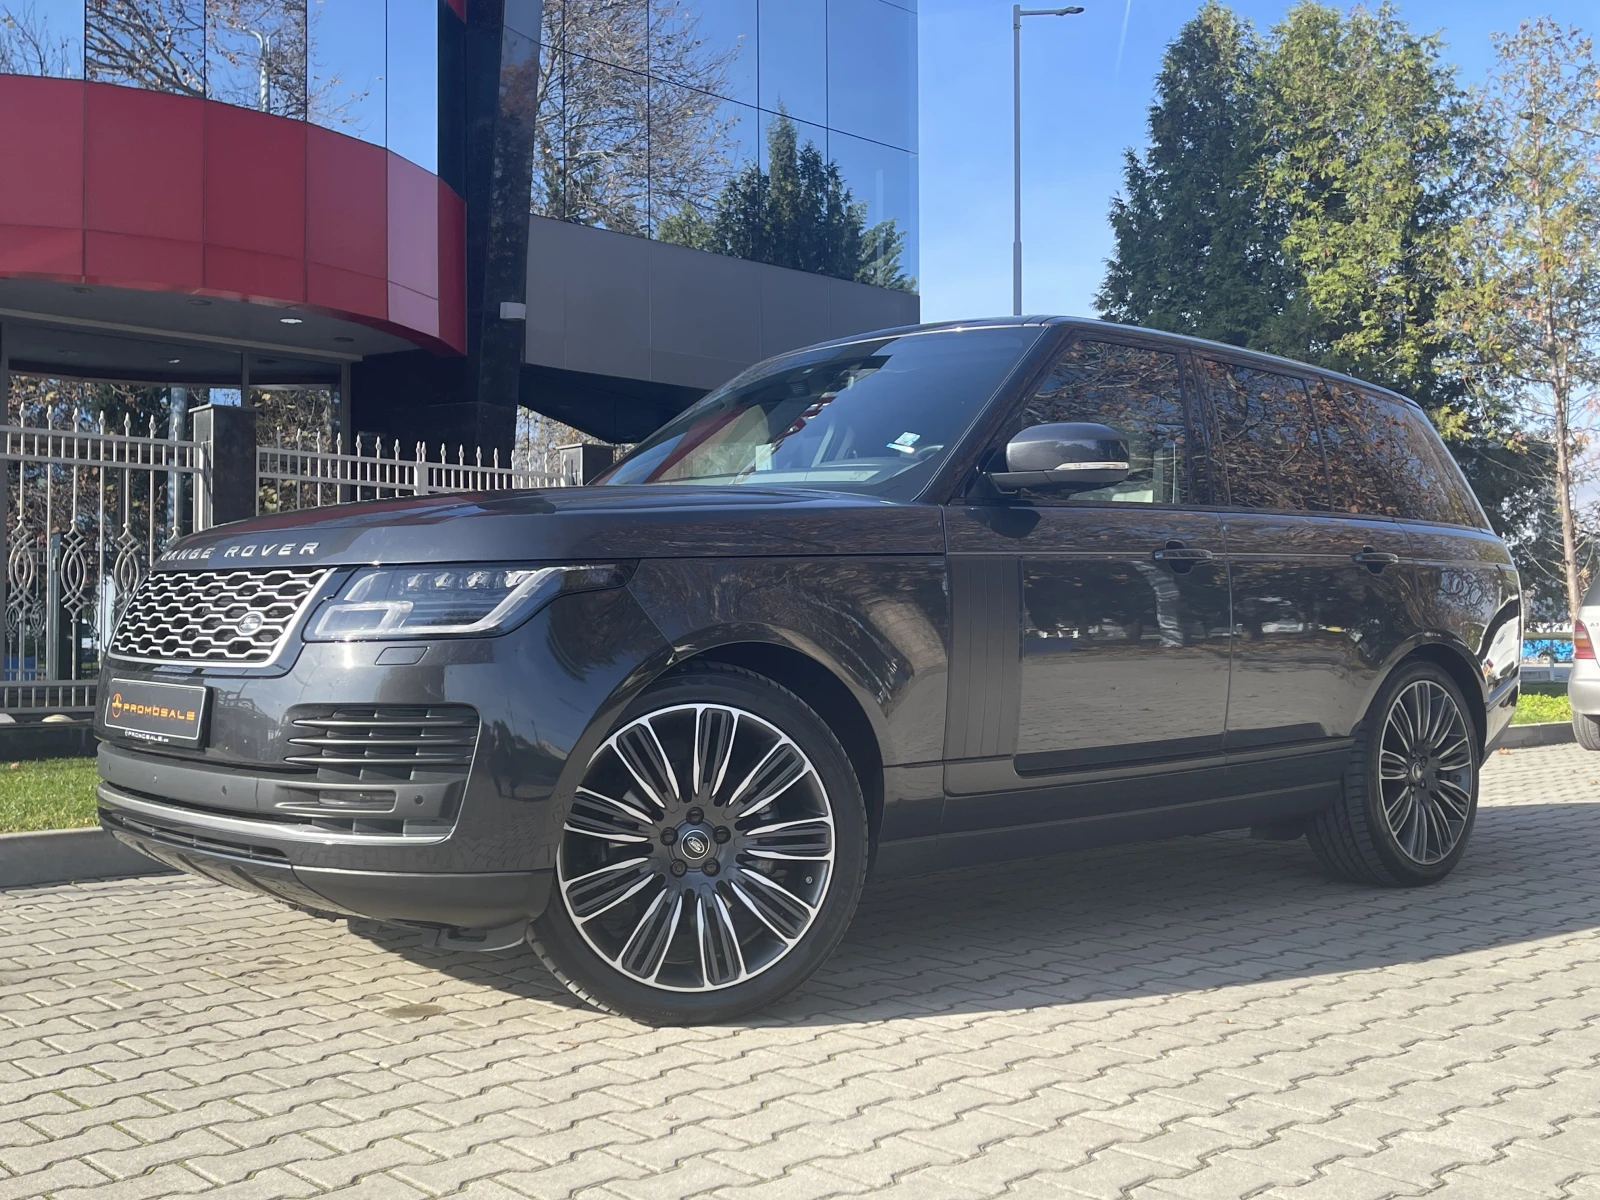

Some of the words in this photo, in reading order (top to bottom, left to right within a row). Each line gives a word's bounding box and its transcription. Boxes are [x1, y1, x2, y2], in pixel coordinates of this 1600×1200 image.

[160, 547, 215, 561] RANGE
[223, 542, 320, 558] ROVER
[123, 703, 195, 721] PROMOSALE
